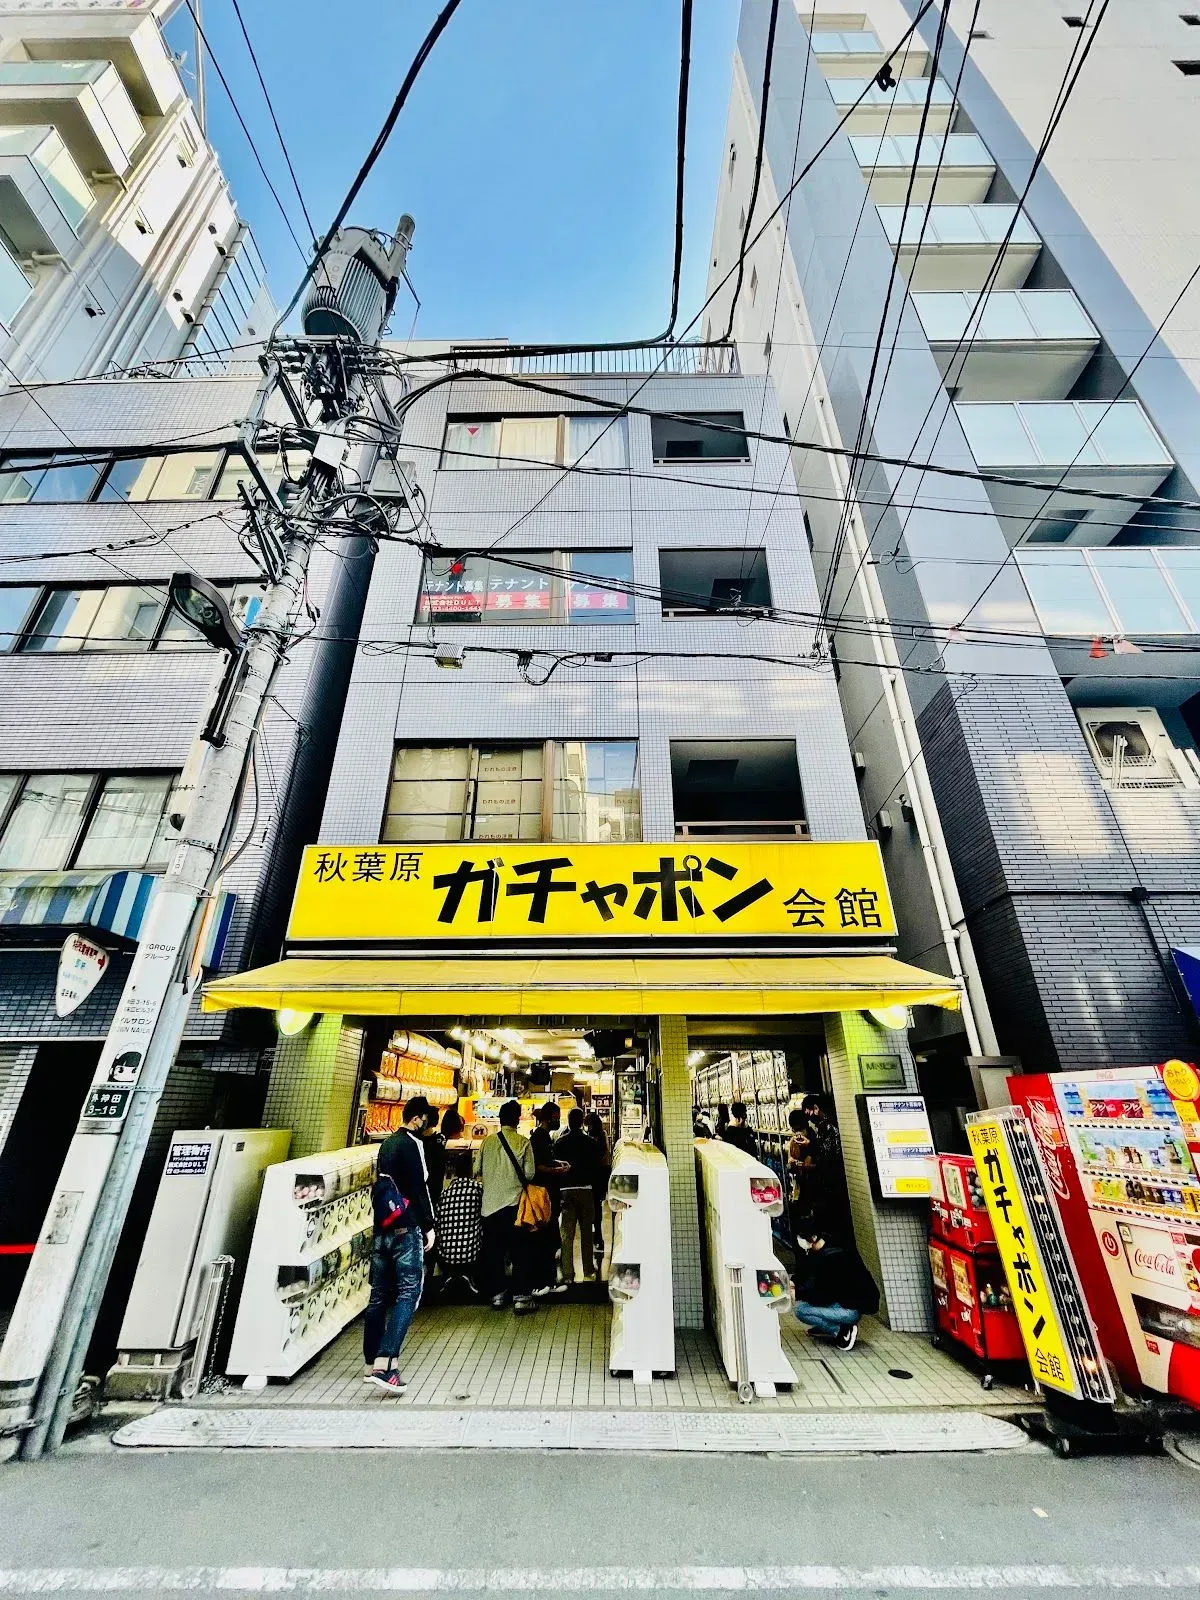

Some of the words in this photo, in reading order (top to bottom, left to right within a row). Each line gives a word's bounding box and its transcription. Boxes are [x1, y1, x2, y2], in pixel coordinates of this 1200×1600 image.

[426, 579, 484, 592] テナント募集
[489, 577, 549, 590] テナント
[495, 593, 541, 608] 募集
[313, 851, 424, 883] 秋葉原
[432, 854, 775, 924] ガチャポン
[783, 887, 883, 928] 会館
[87, 1105, 118, 1115] 3-15
[970, 1126, 999, 1146] 秋葉原
[172, 1145, 211, 1157] 管理物件
[983, 1147, 1047, 1340] ガチャポン
[1034, 1347, 1065, 1382] 会館
